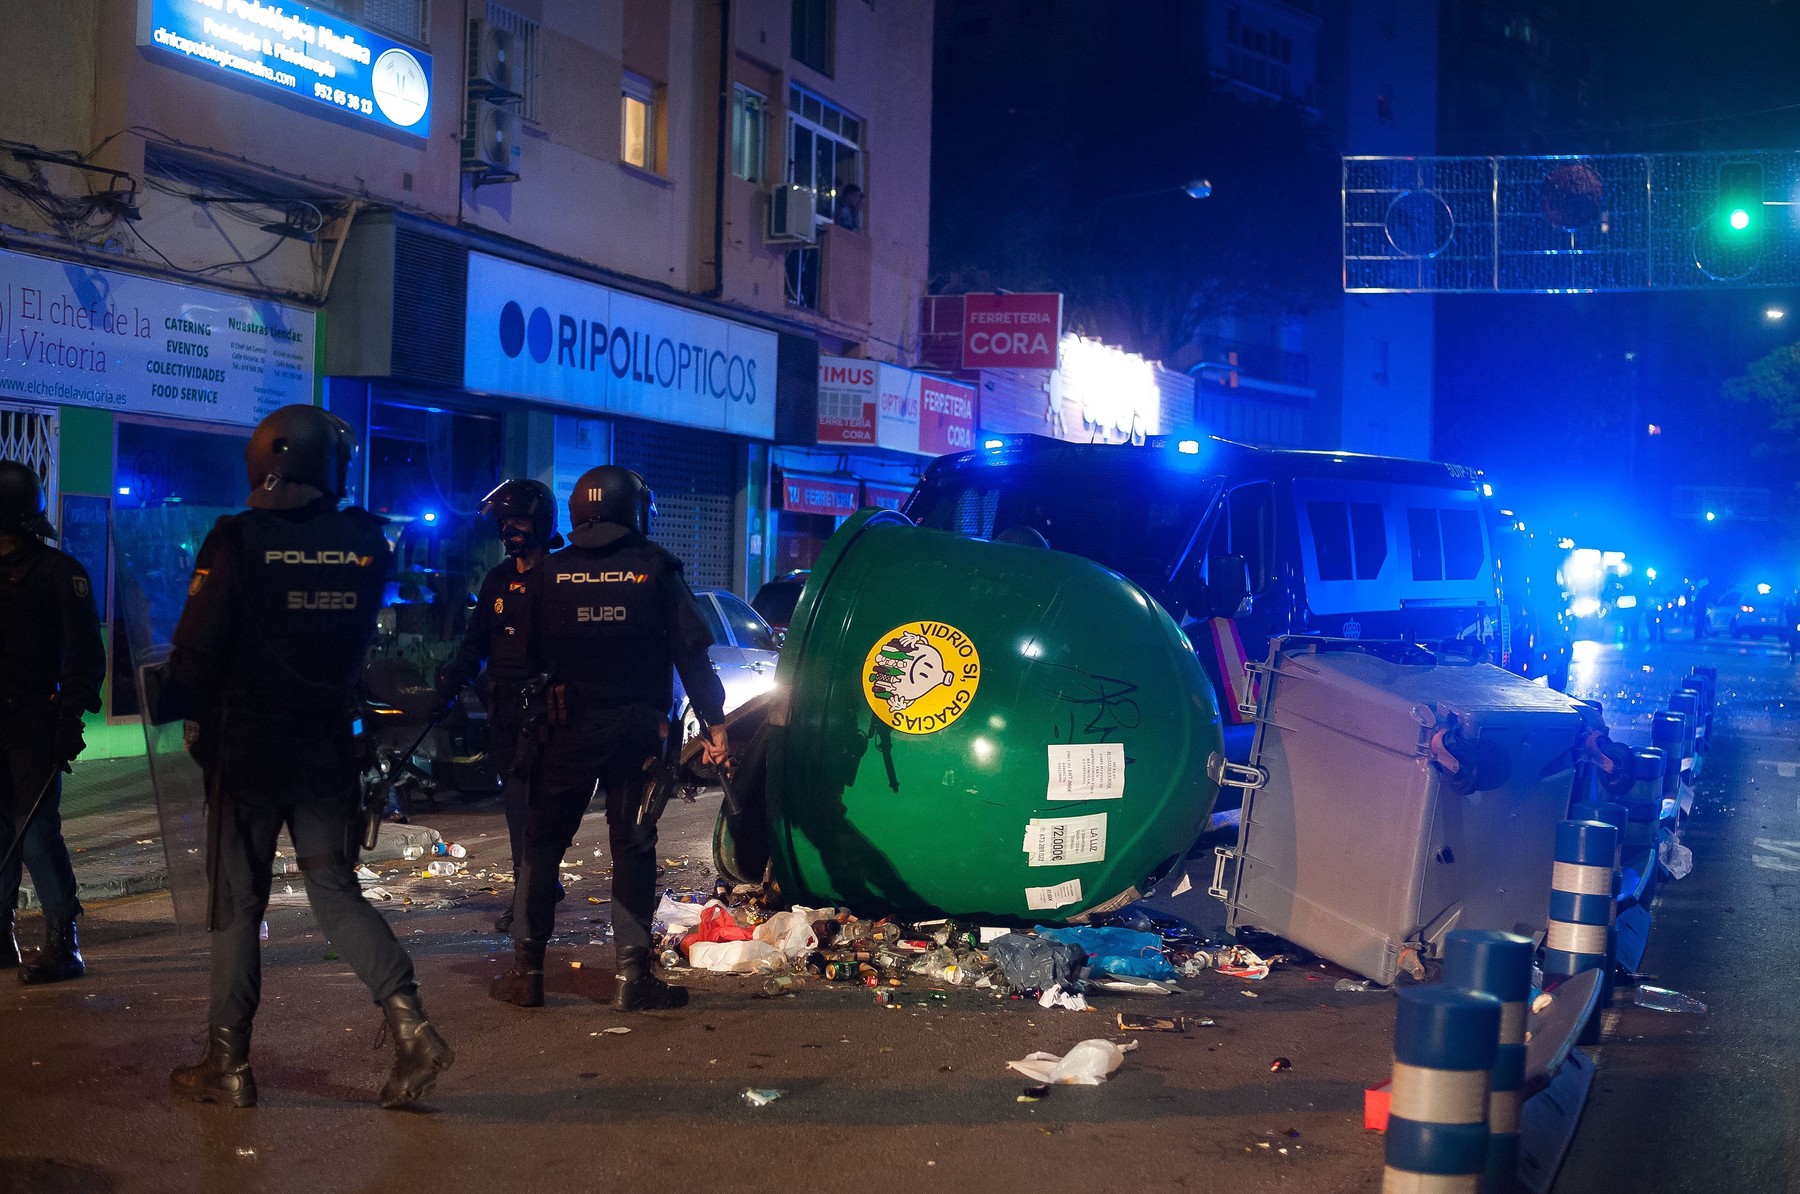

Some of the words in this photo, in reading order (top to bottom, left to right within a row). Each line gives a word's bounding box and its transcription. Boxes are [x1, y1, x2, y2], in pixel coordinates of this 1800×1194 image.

[20, 287, 42, 321] El
[49, 294, 98, 331] chef
[102, 303, 128, 336] de
[134, 307, 151, 339] la
[970, 312, 1050, 325] FERRETERIA
[164, 316, 212, 337] CATERING
[228, 317, 268, 336] Nuestras
[270, 325, 303, 343] tiendas:
[20, 328, 107, 373] Victoria
[166, 340, 209, 358] EVENTOS
[969, 332, 1050, 355] CORA
[146, 359, 226, 383] COLECTIVIDADES
[818, 365, 874, 386] IMUS
[151, 383, 179, 400] FOOD
[180, 387, 218, 404] SERVICE
[842, 429, 871, 440] CORA
[947, 425, 971, 449] CORA
[265, 550, 360, 564] POLICIA
[556, 571, 637, 584] POLICIA
[920, 623, 974, 658] VIDRIO
[959, 663, 978, 682] SI,
[891, 689, 971, 731] GRACIAS
[1052, 825, 1065, 862] 72.000€
